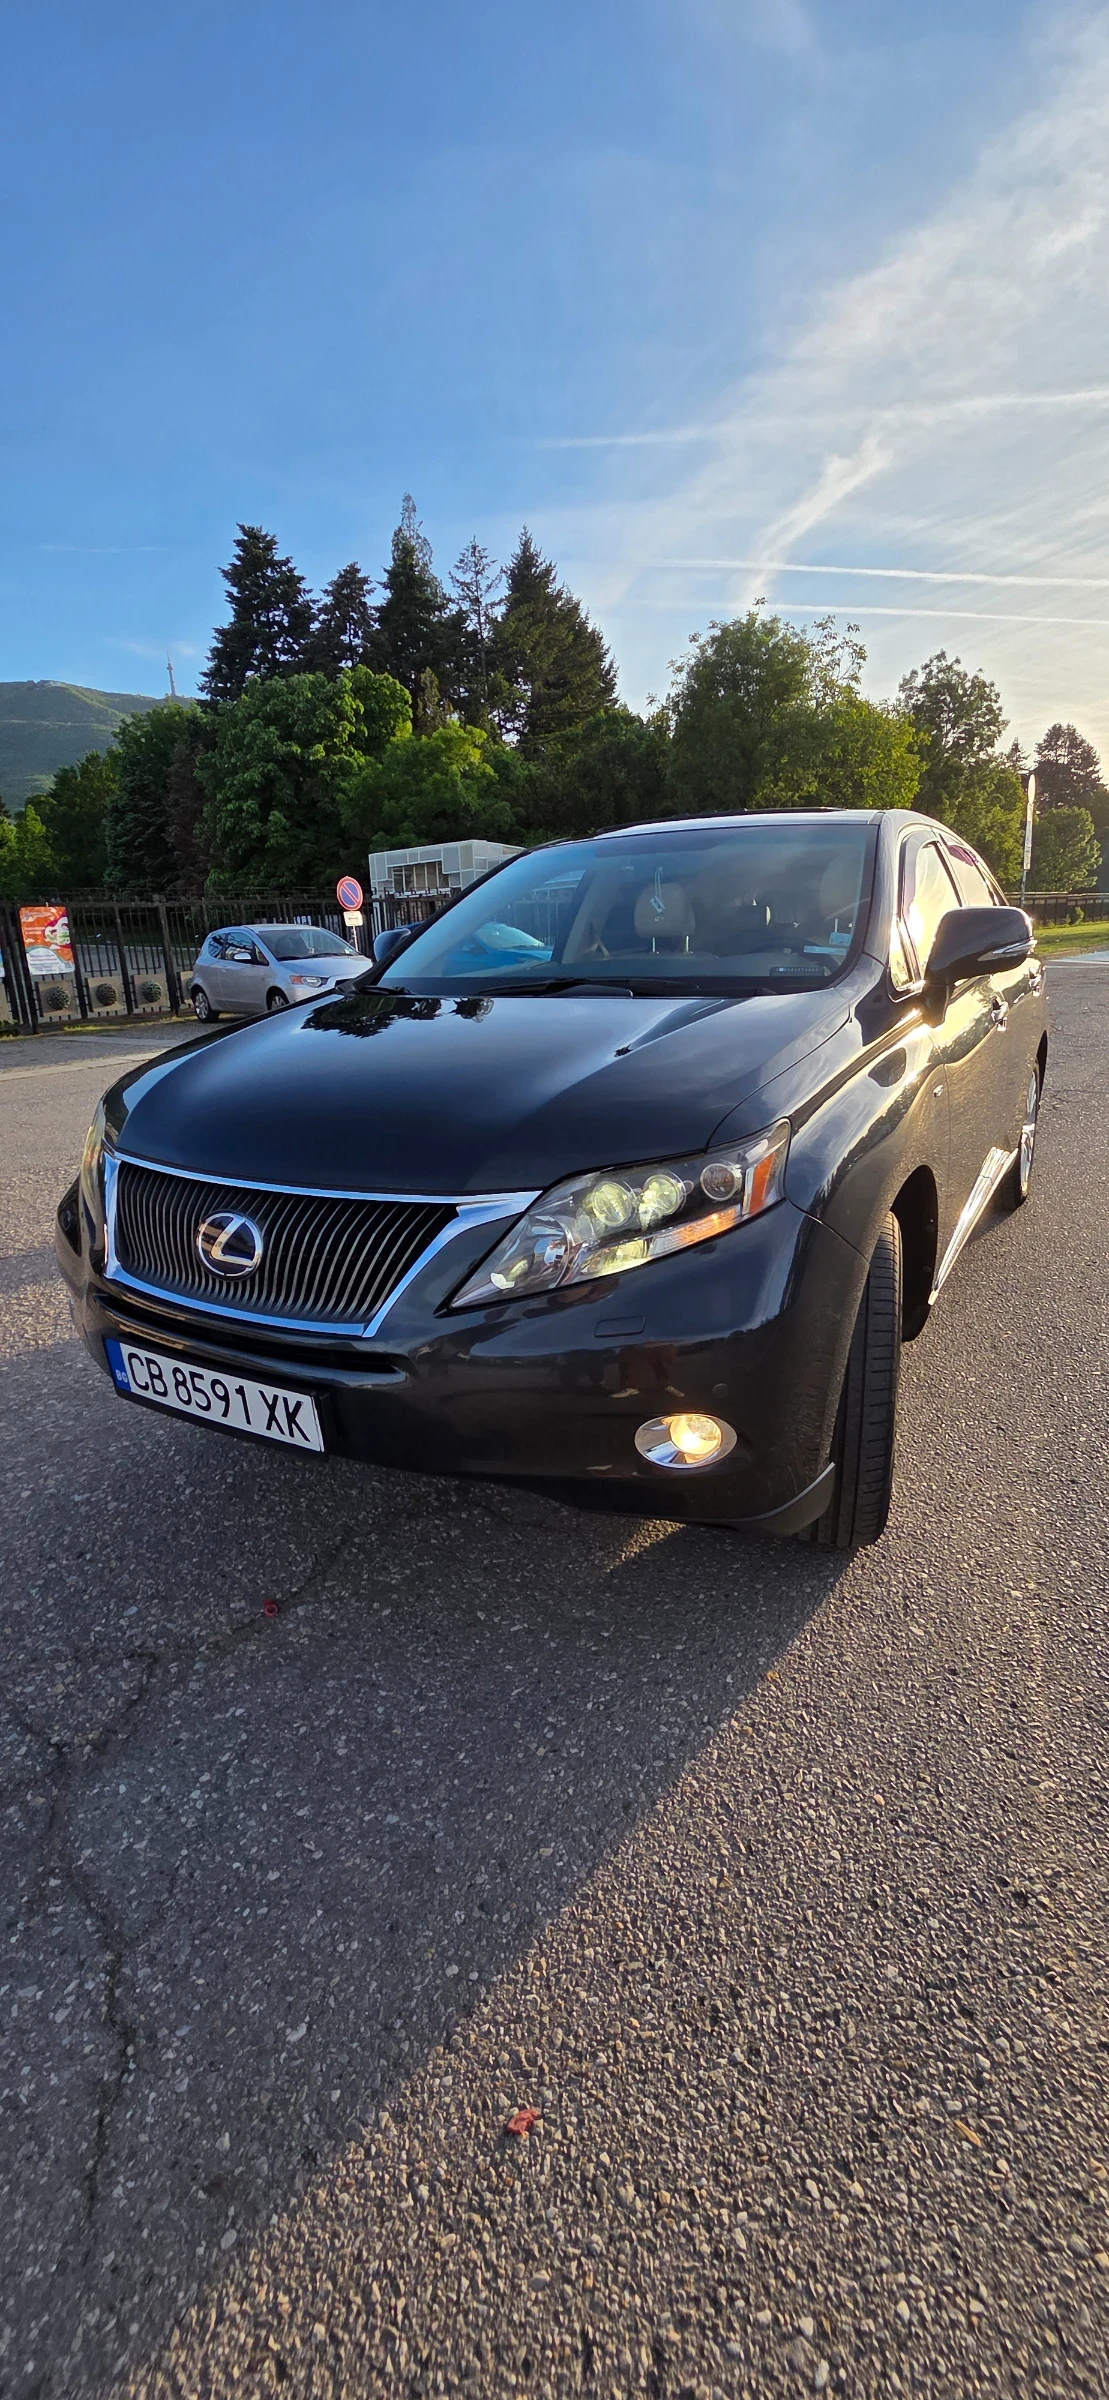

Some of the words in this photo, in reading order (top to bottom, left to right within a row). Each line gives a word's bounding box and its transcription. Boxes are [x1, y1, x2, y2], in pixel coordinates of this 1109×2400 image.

[115, 1369, 128, 1383] BG
[127, 1352, 168, 1397] CB
[172, 1367, 251, 1425] 8591
[258, 1389, 311, 1443] XK
